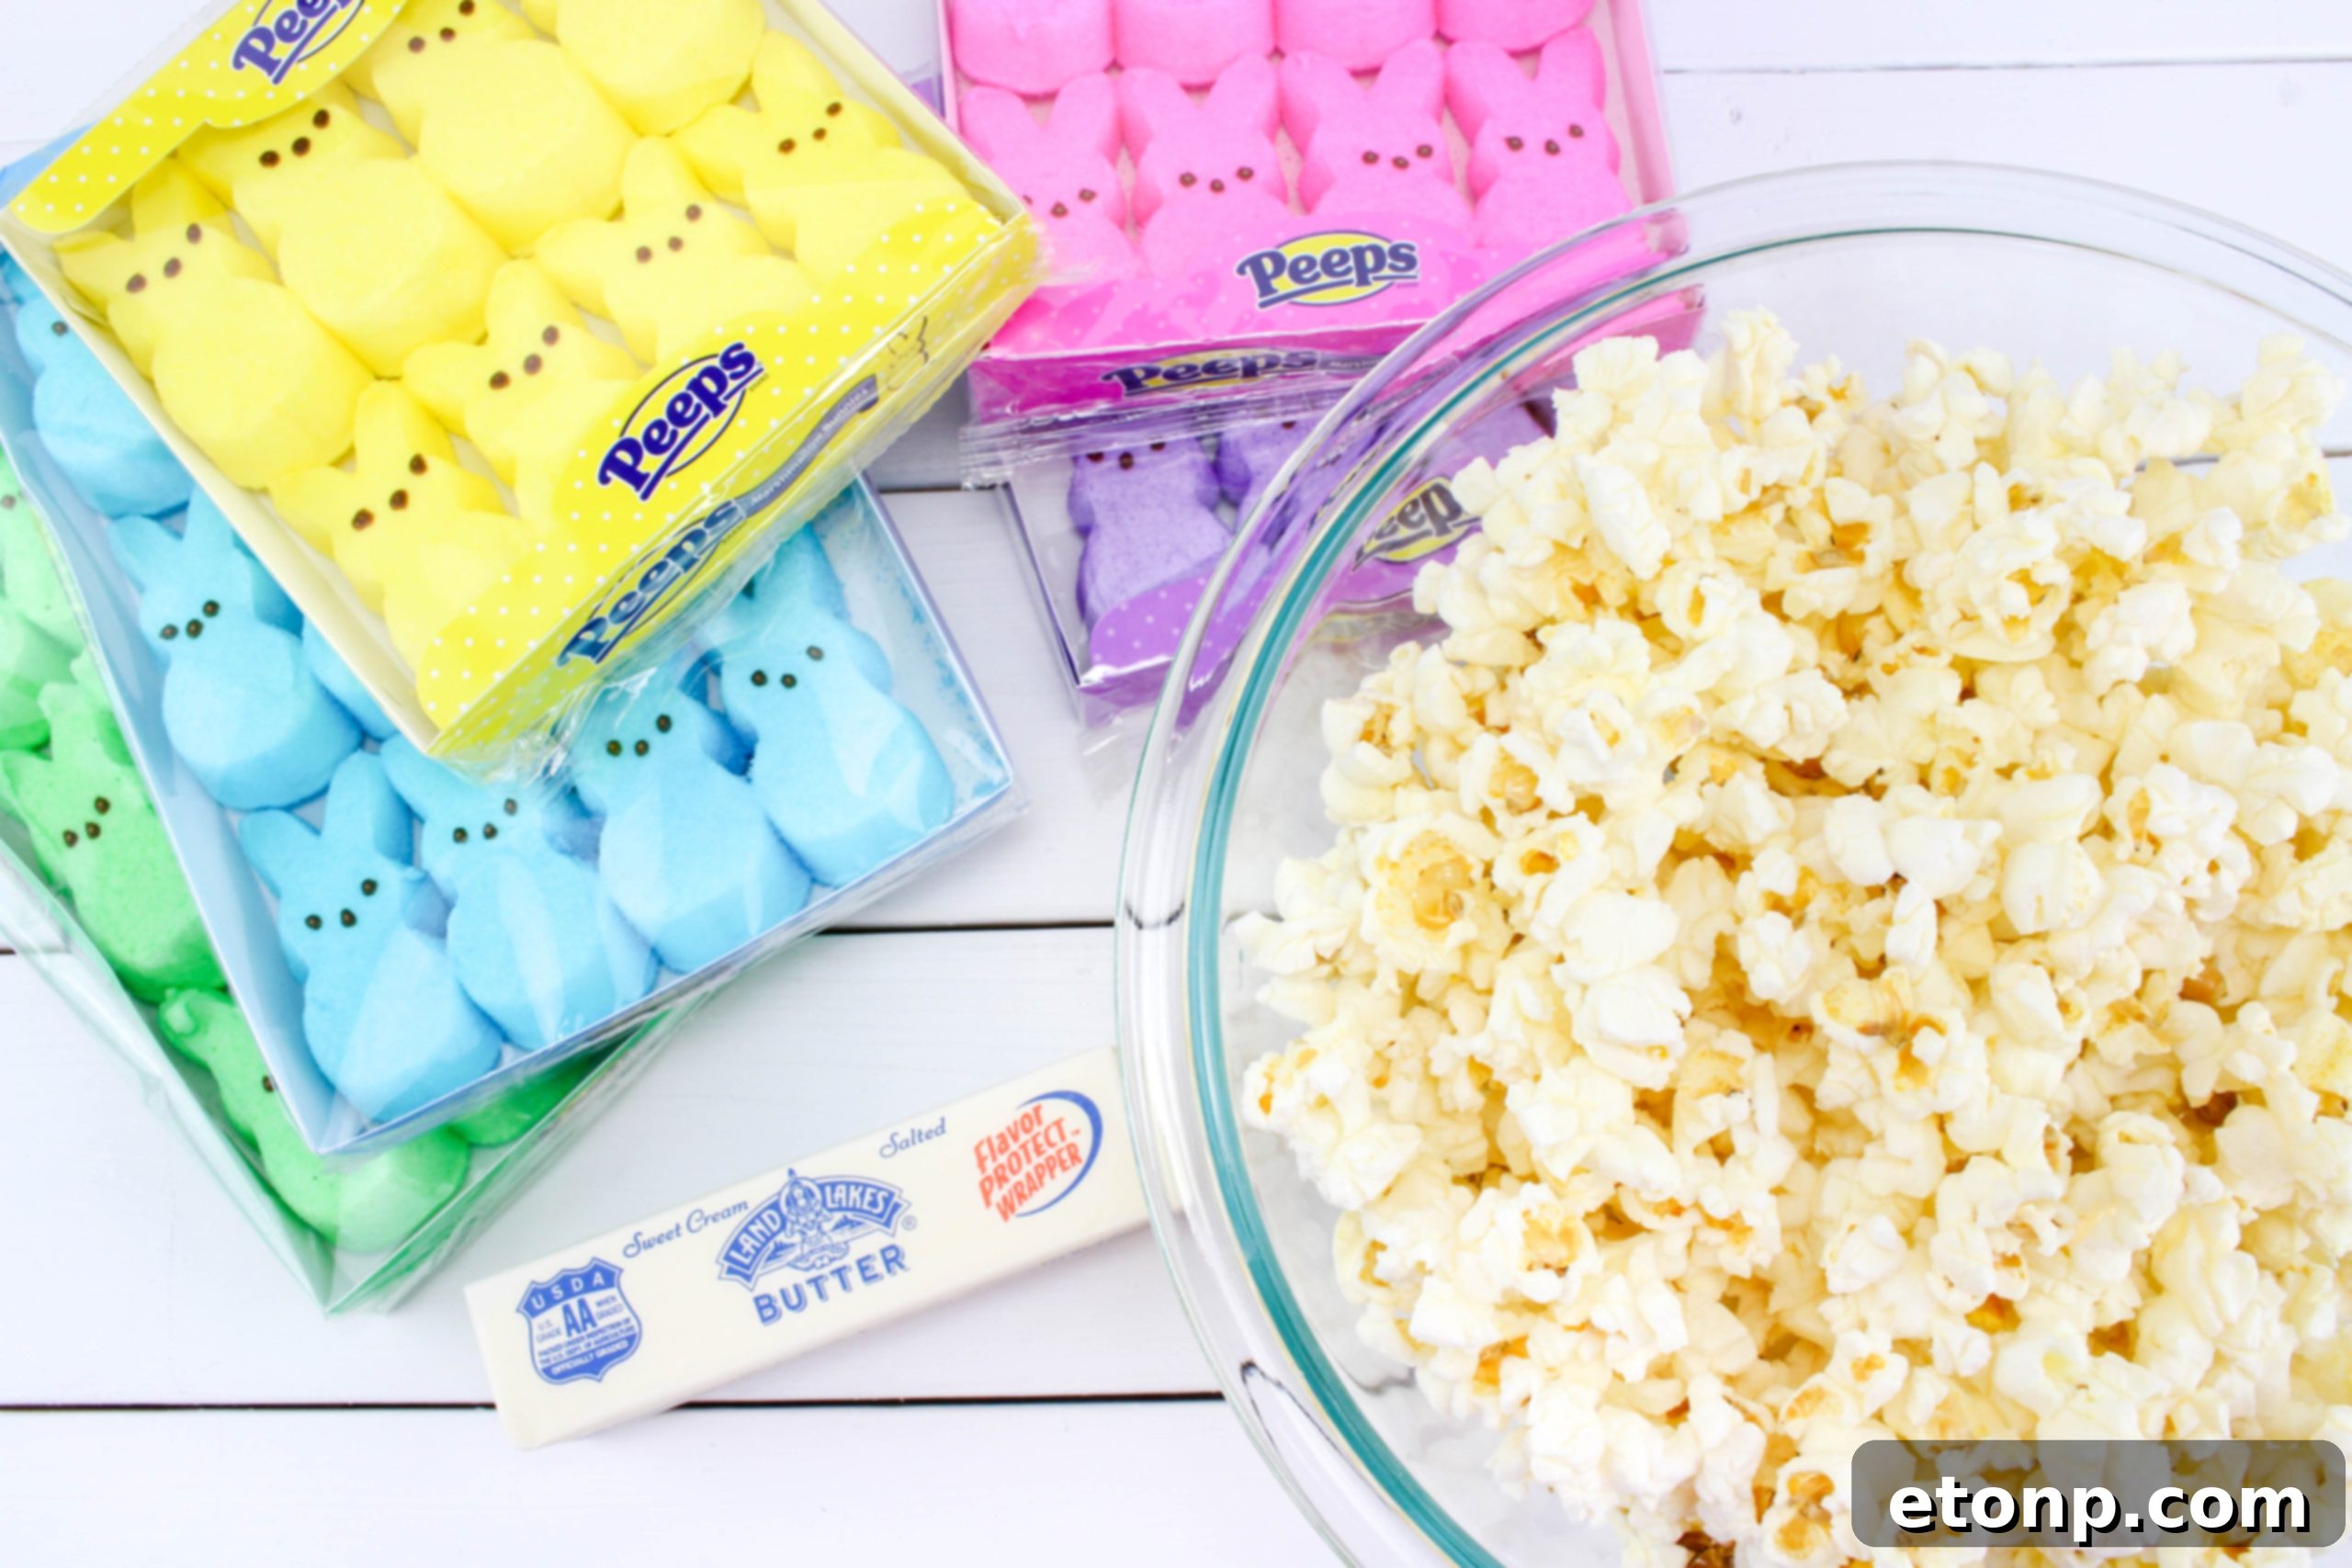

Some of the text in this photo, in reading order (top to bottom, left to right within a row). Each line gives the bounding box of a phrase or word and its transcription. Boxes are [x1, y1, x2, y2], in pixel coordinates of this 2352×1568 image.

[1237, 242, 1418, 299] Peeps
[1101, 351, 1318, 393] Peeps
[598, 342, 757, 494] Peeps
[557, 500, 741, 665] Peeps
[878, 1116, 946, 1158] Salted
[974, 1104, 1043, 1174] Flavor
[978, 1117, 1067, 1209] PROTECT
[996, 1143, 1082, 1223] WRAPPER
[623, 1201, 749, 1258] Sweet Cream
[729, 1184, 888, 1265] LAND LAKES
[531, 1271, 605, 1309] USDA
[562, 1297, 597, 1337] AA
[753, 1244, 908, 1325] BUTTER
